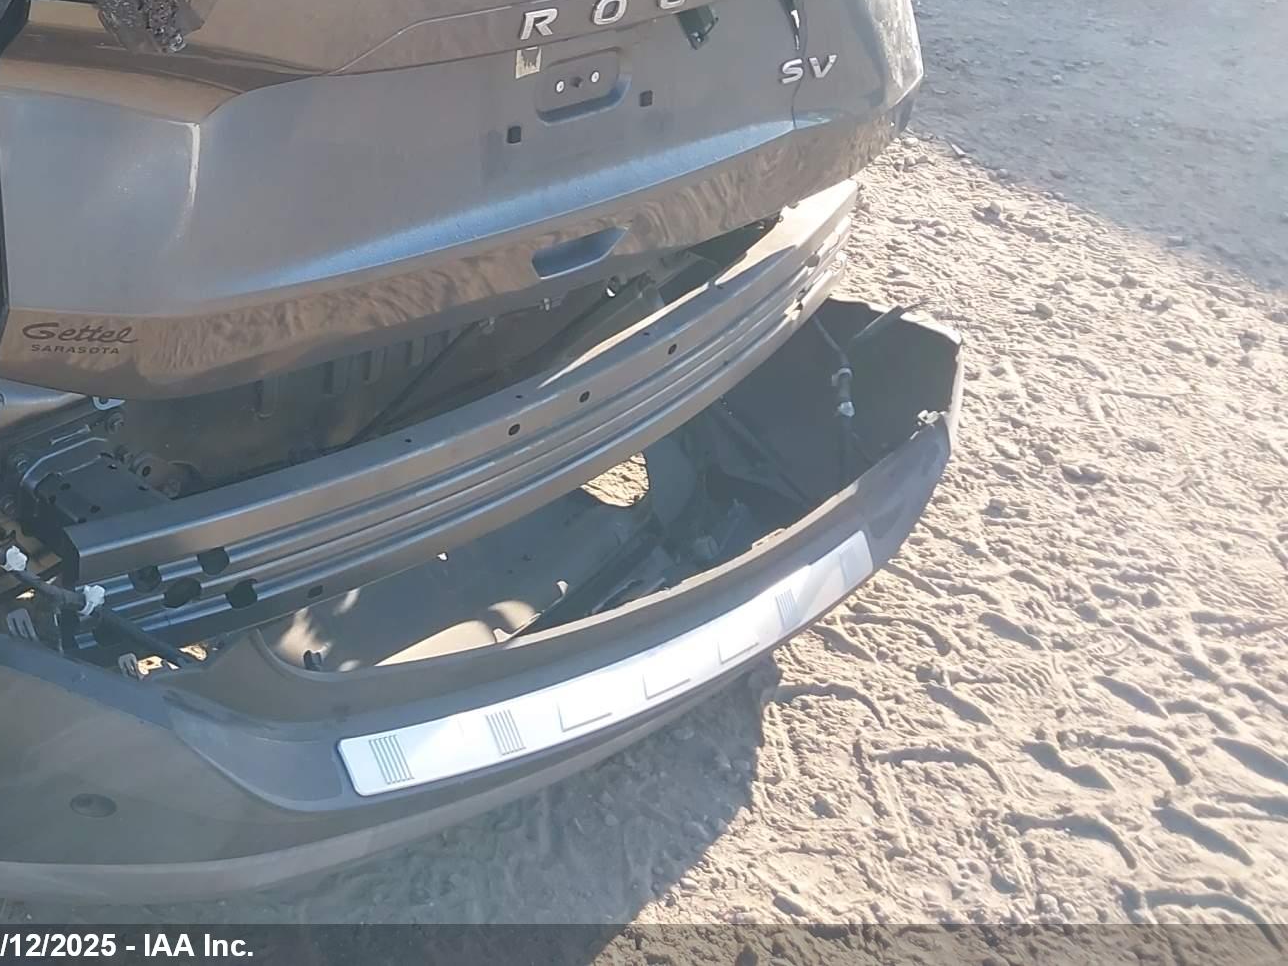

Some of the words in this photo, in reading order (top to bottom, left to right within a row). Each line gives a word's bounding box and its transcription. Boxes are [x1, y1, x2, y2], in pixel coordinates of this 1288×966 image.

[780, 54, 838, 84] SV
[22, 322, 138, 344] Gettel
[31, 344, 119, 355] SARASOTA
